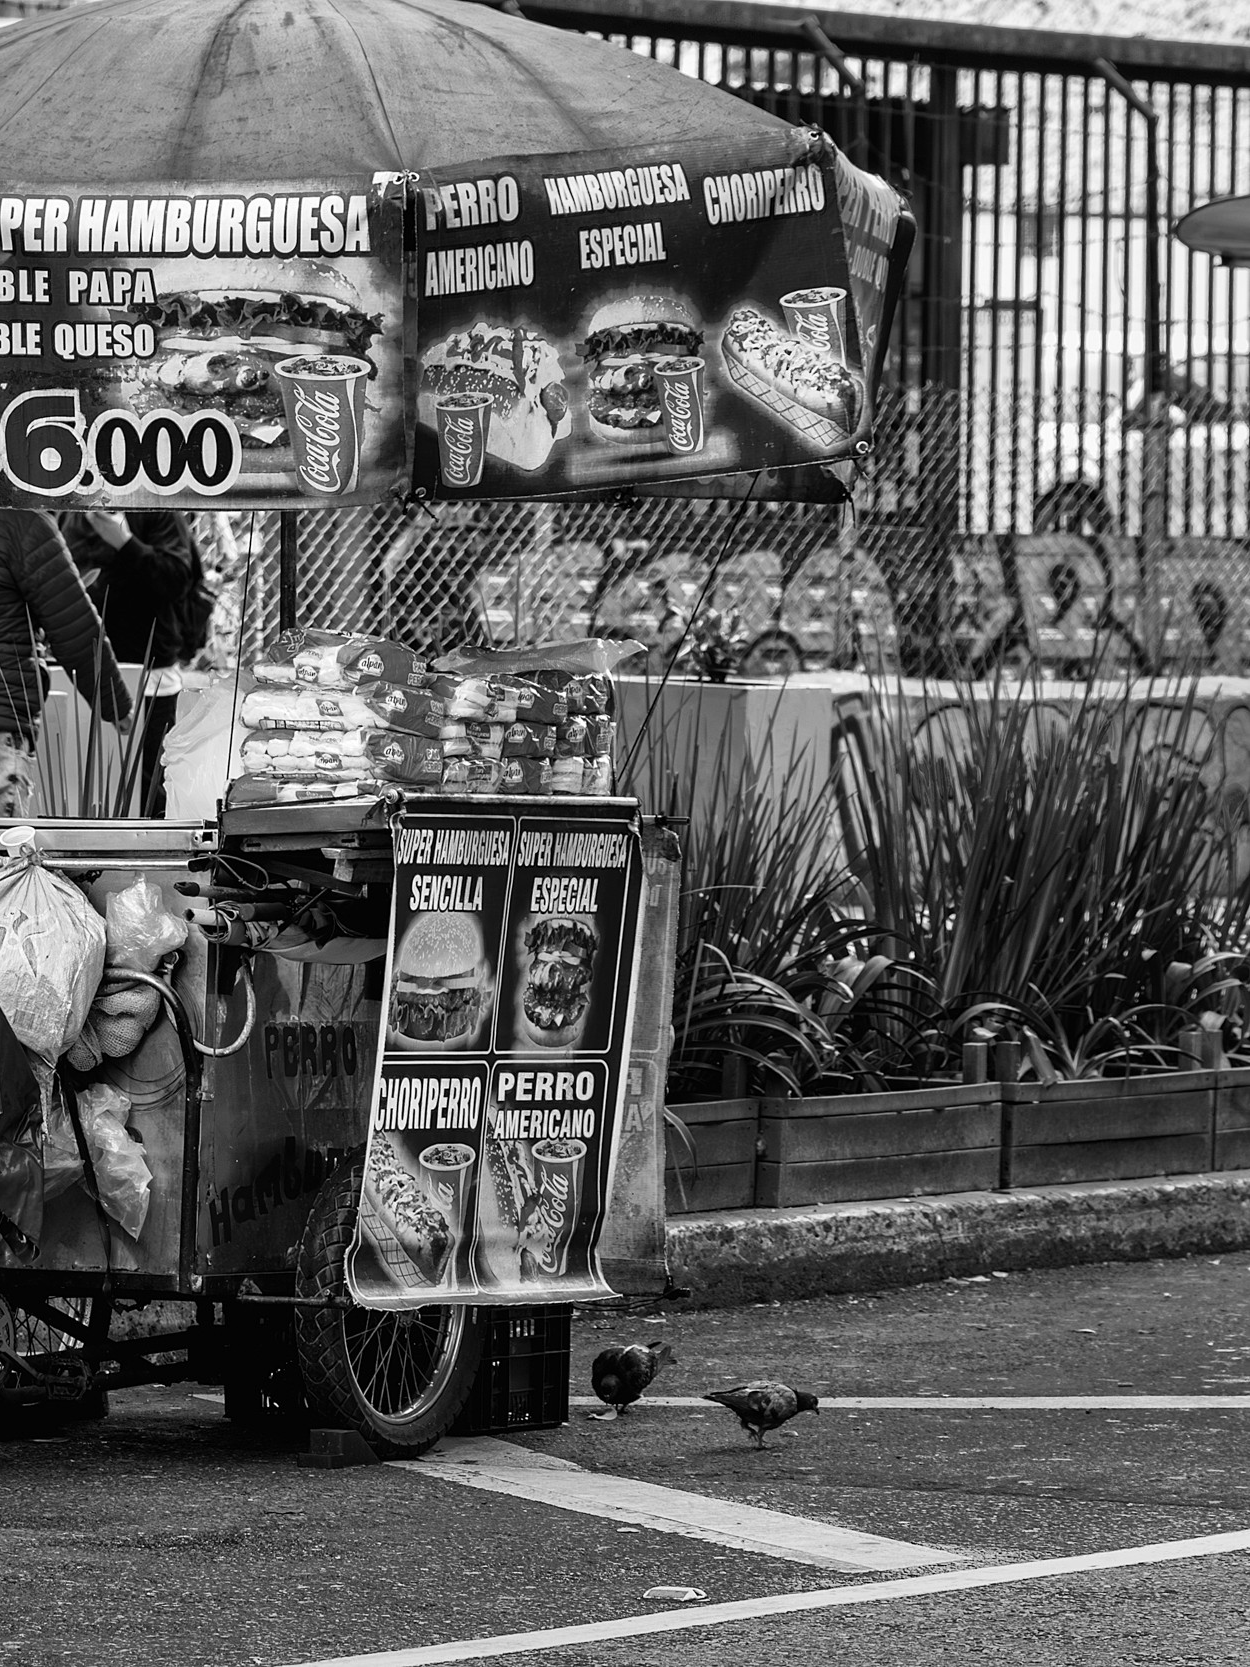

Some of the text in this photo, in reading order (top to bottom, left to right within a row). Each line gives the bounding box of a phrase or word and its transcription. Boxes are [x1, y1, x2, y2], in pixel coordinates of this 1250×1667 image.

[425, 176, 520, 230] PERRO
[545, 163, 689, 217] HAMBURGUESA
[704, 164, 825, 226] CHORIPERRO
[79, 195, 371, 256] HAMBURGUESA
[579, 222, 667, 270] ESPECIAL
[68, 270, 155, 304] PAPA
[425, 240, 534, 297] AMERICANO
[54, 322, 155, 358] QUESO
[396, 828, 510, 867] SUPER HAMBURGUESA
[518, 831, 552, 865] SUPER
[553, 832, 628, 869] HAMBURGUESA
[409, 875, 483, 912] SENCILLA
[530, 876, 599, 914] ESPECIAL
[264, 1025, 357, 1079] PERRO
[375, 1077, 481, 1132] CHORIPERRO
[498, 1071, 595, 1102] PERRO
[493, 1108, 595, 1140] AMERICANO
